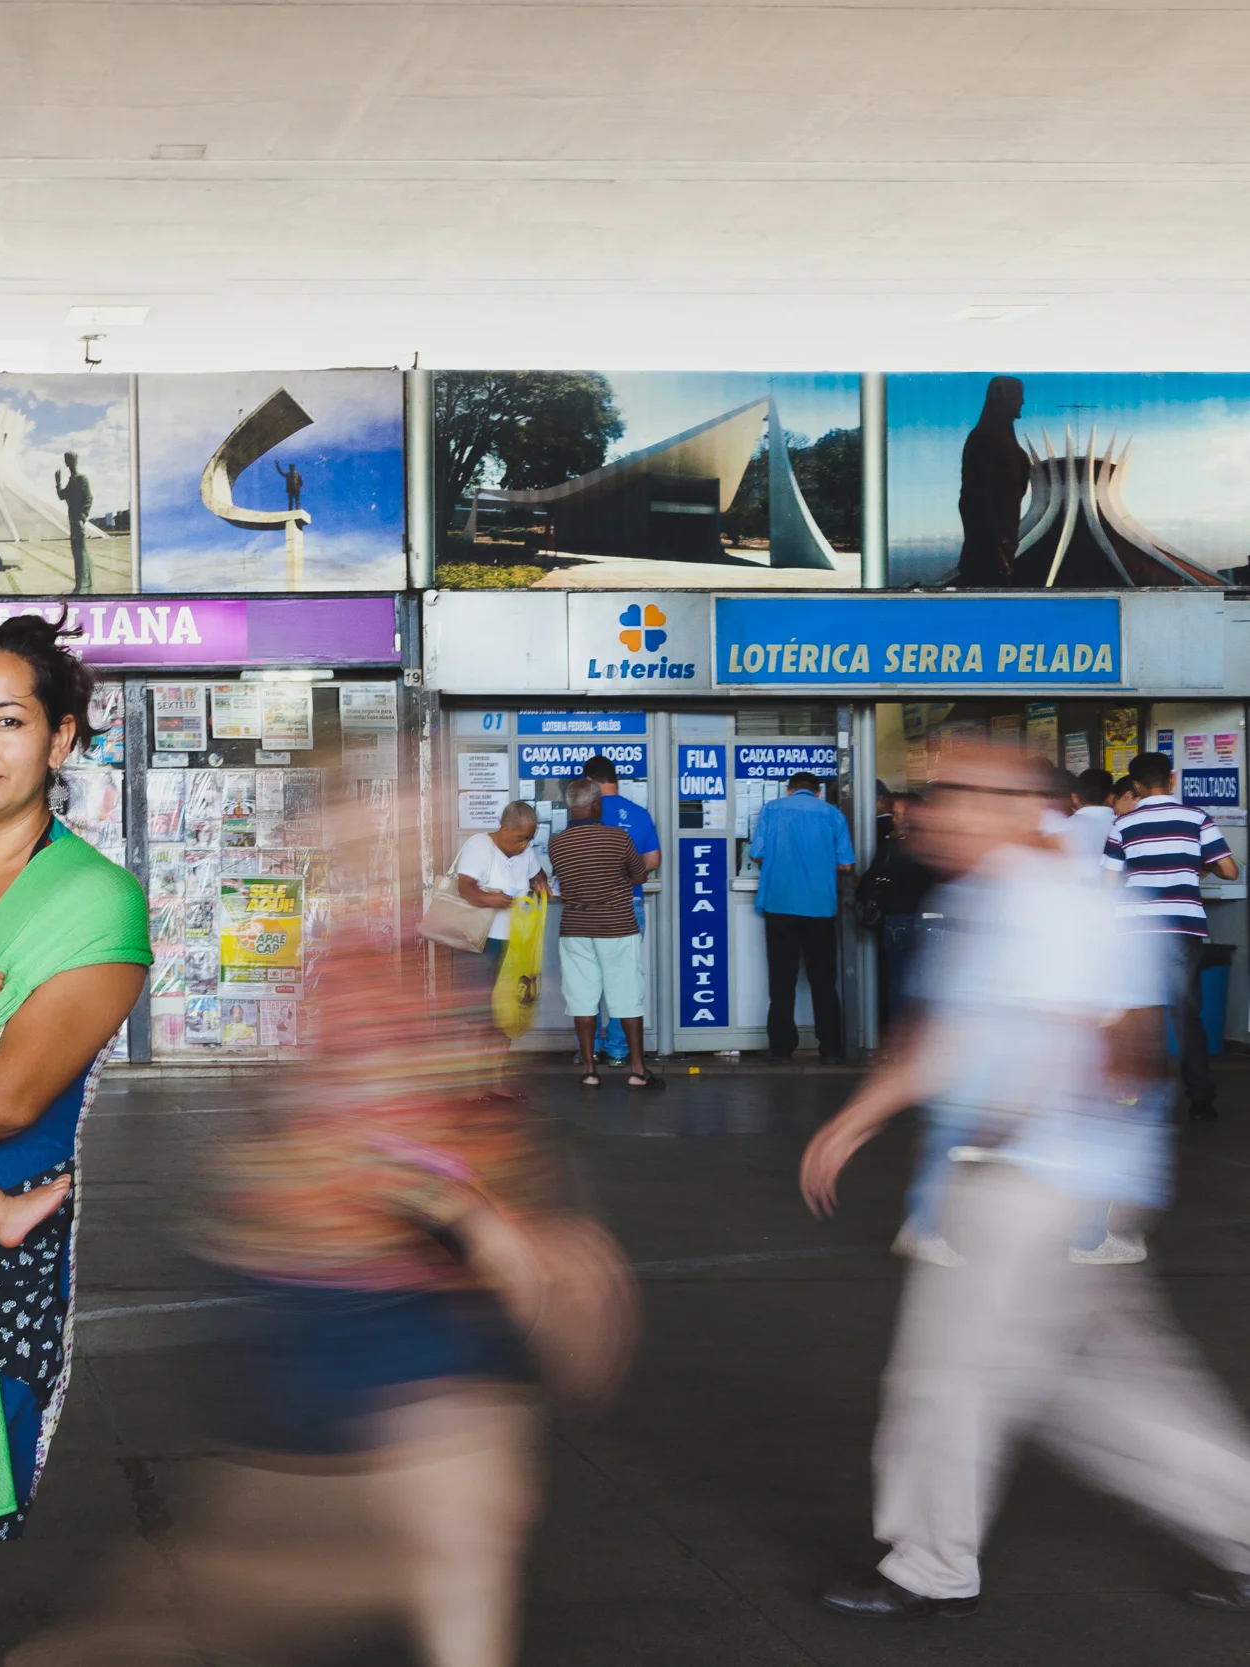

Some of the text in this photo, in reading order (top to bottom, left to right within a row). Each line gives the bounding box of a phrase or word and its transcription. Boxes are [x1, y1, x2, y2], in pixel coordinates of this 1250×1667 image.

[729, 637, 1114, 674] LOTÉRICA SERRA PELADA
[588, 656, 695, 680] Loterias
[405, 672, 421, 683] 19
[157, 701, 196, 710] SEXTETO
[482, 713, 503, 730] 01
[542, 721, 567, 732] LOTERIA
[522, 746, 643, 762] CAIXA PARA JOGOS
[687, 749, 718, 769] FILA
[740, 748, 775, 763] CAIXA
[777, 749, 808, 763] PARA
[531, 763, 549, 776] SÓ
[552, 766, 571, 775] EM
[748, 765, 837, 777] SÓ EM DINHEIR
[680, 772, 725, 796] ÚNICA
[1184, 776, 1237, 798] RESULTADOS
[691, 845, 715, 912] FILA
[248, 883, 287, 898] SELE
[245, 897, 295, 912] AQUI!
[256, 933, 287, 943] APAE
[255, 943, 281, 954] CAP
[691, 932, 715, 1021] ÚNICA
